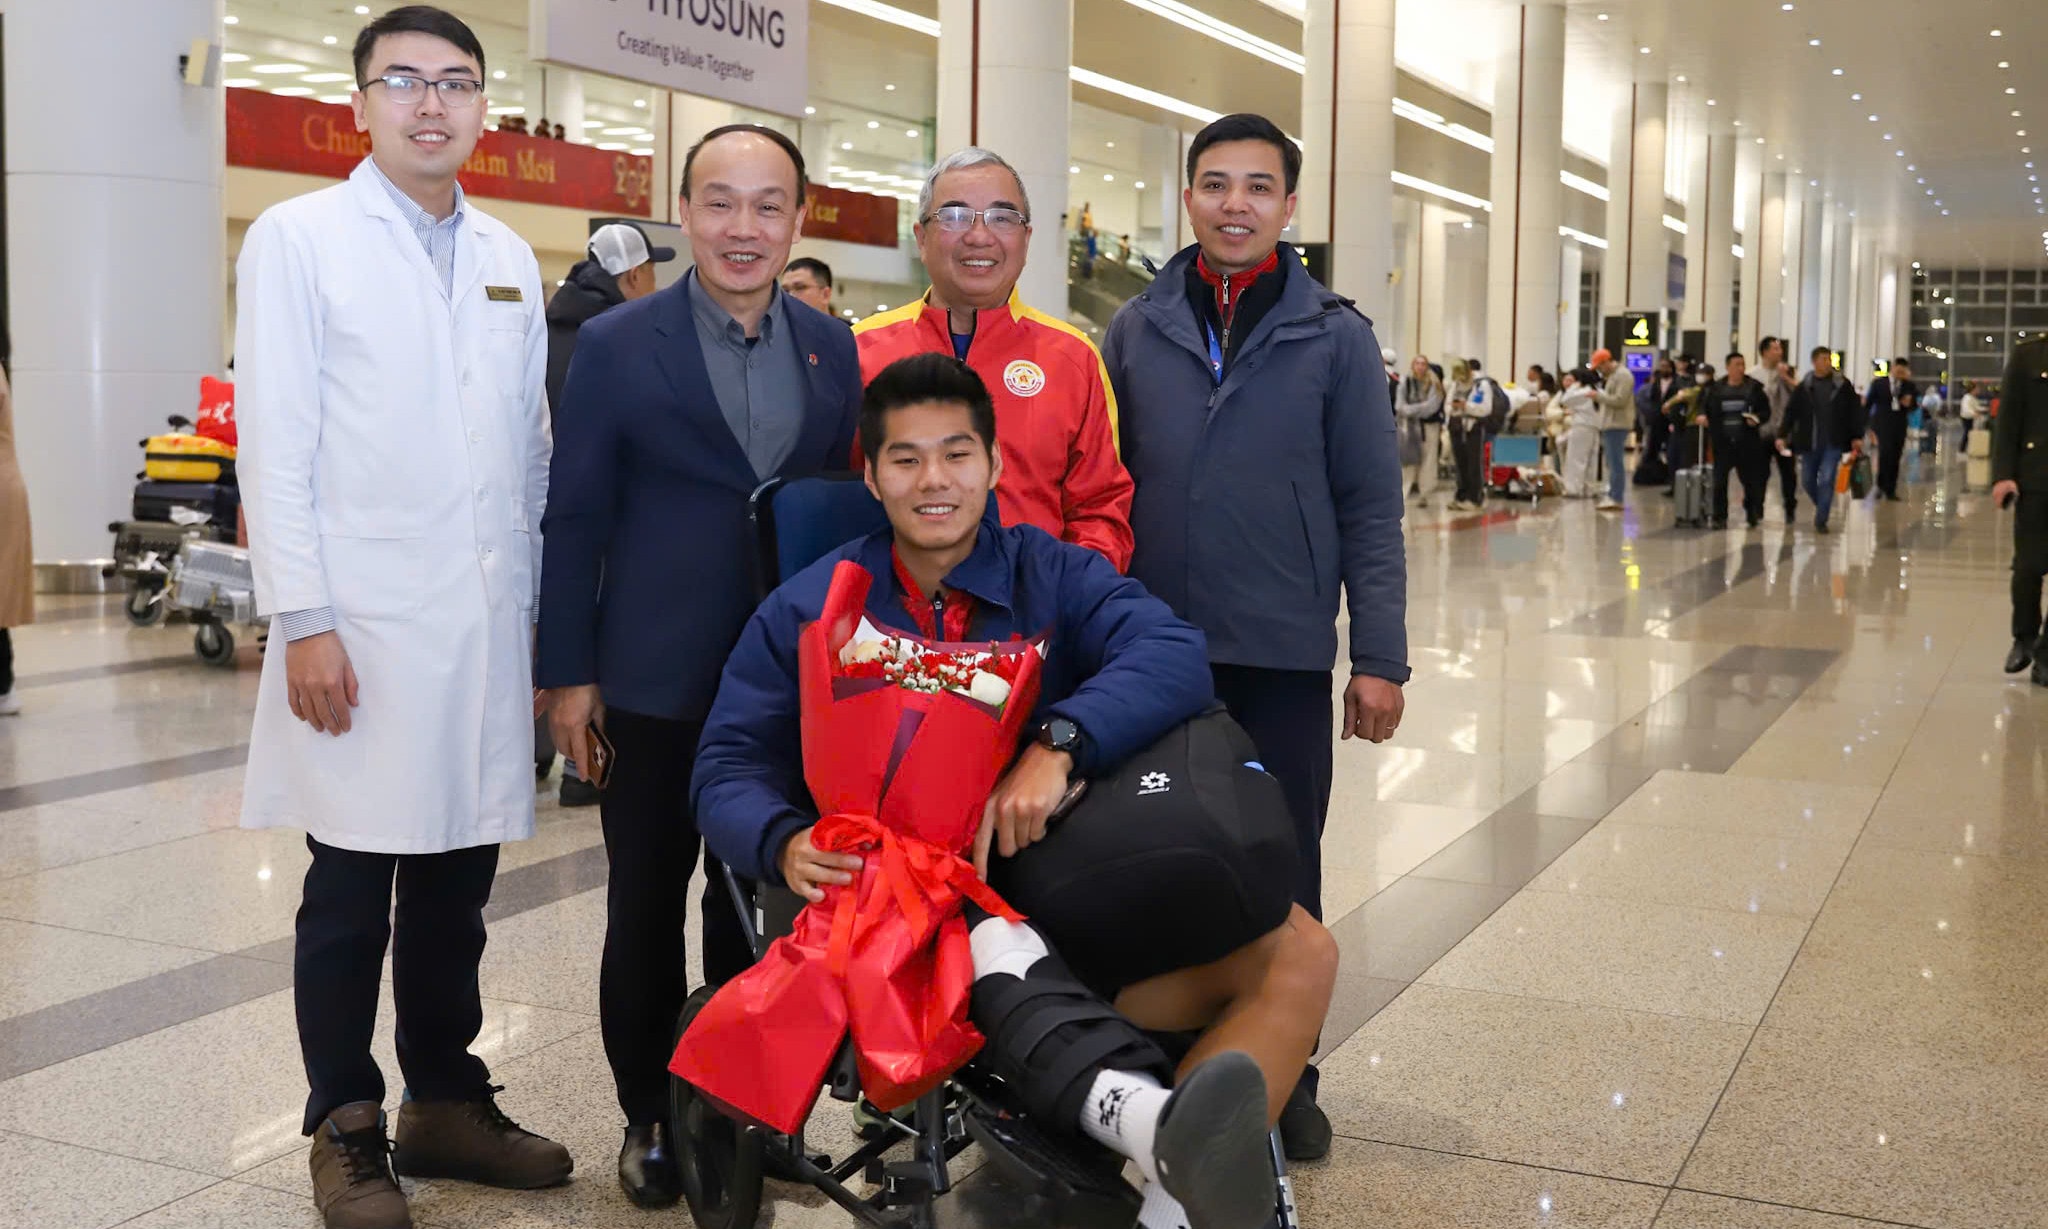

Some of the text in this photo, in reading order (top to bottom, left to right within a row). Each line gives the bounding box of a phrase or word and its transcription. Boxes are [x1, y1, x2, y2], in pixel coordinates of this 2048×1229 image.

[617, 30, 755, 82] Creating Value Together
[1632, 318, 1649, 339] 4
